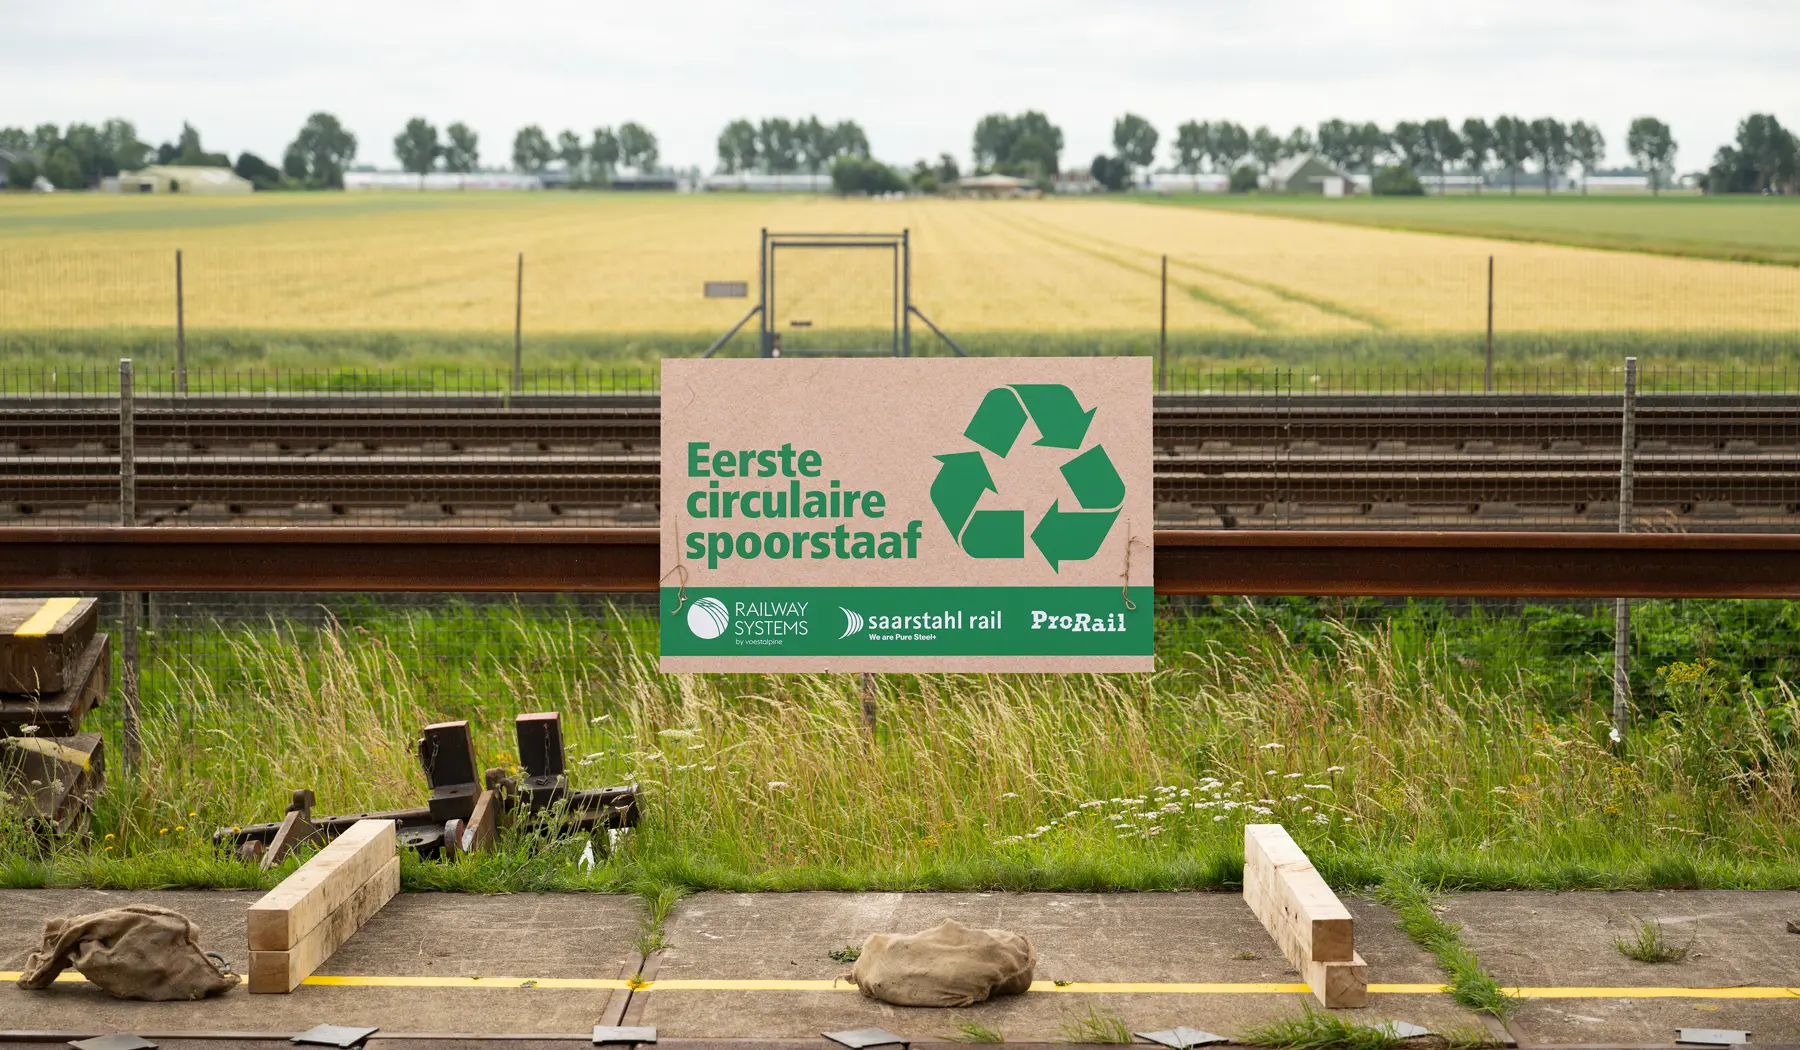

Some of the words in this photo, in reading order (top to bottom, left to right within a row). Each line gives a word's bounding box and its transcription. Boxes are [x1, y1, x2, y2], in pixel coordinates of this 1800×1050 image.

[688, 442, 822, 477] Eerste
[687, 480, 886, 518] circulaire
[686, 519, 922, 569] spoorstaaf
[735, 601, 808, 616] RAILWAY
[735, 620, 808, 636] SYSTEMS
[869, 610, 962, 630] saarstahl
[970, 610, 1001, 630] rail
[1031, 610, 1126, 632] ProRail
[735, 638, 744, 647] by
[745, 638, 783, 647] voestalpine
[868, 633, 881, 641] We
[896, 633, 912, 641] Pure
